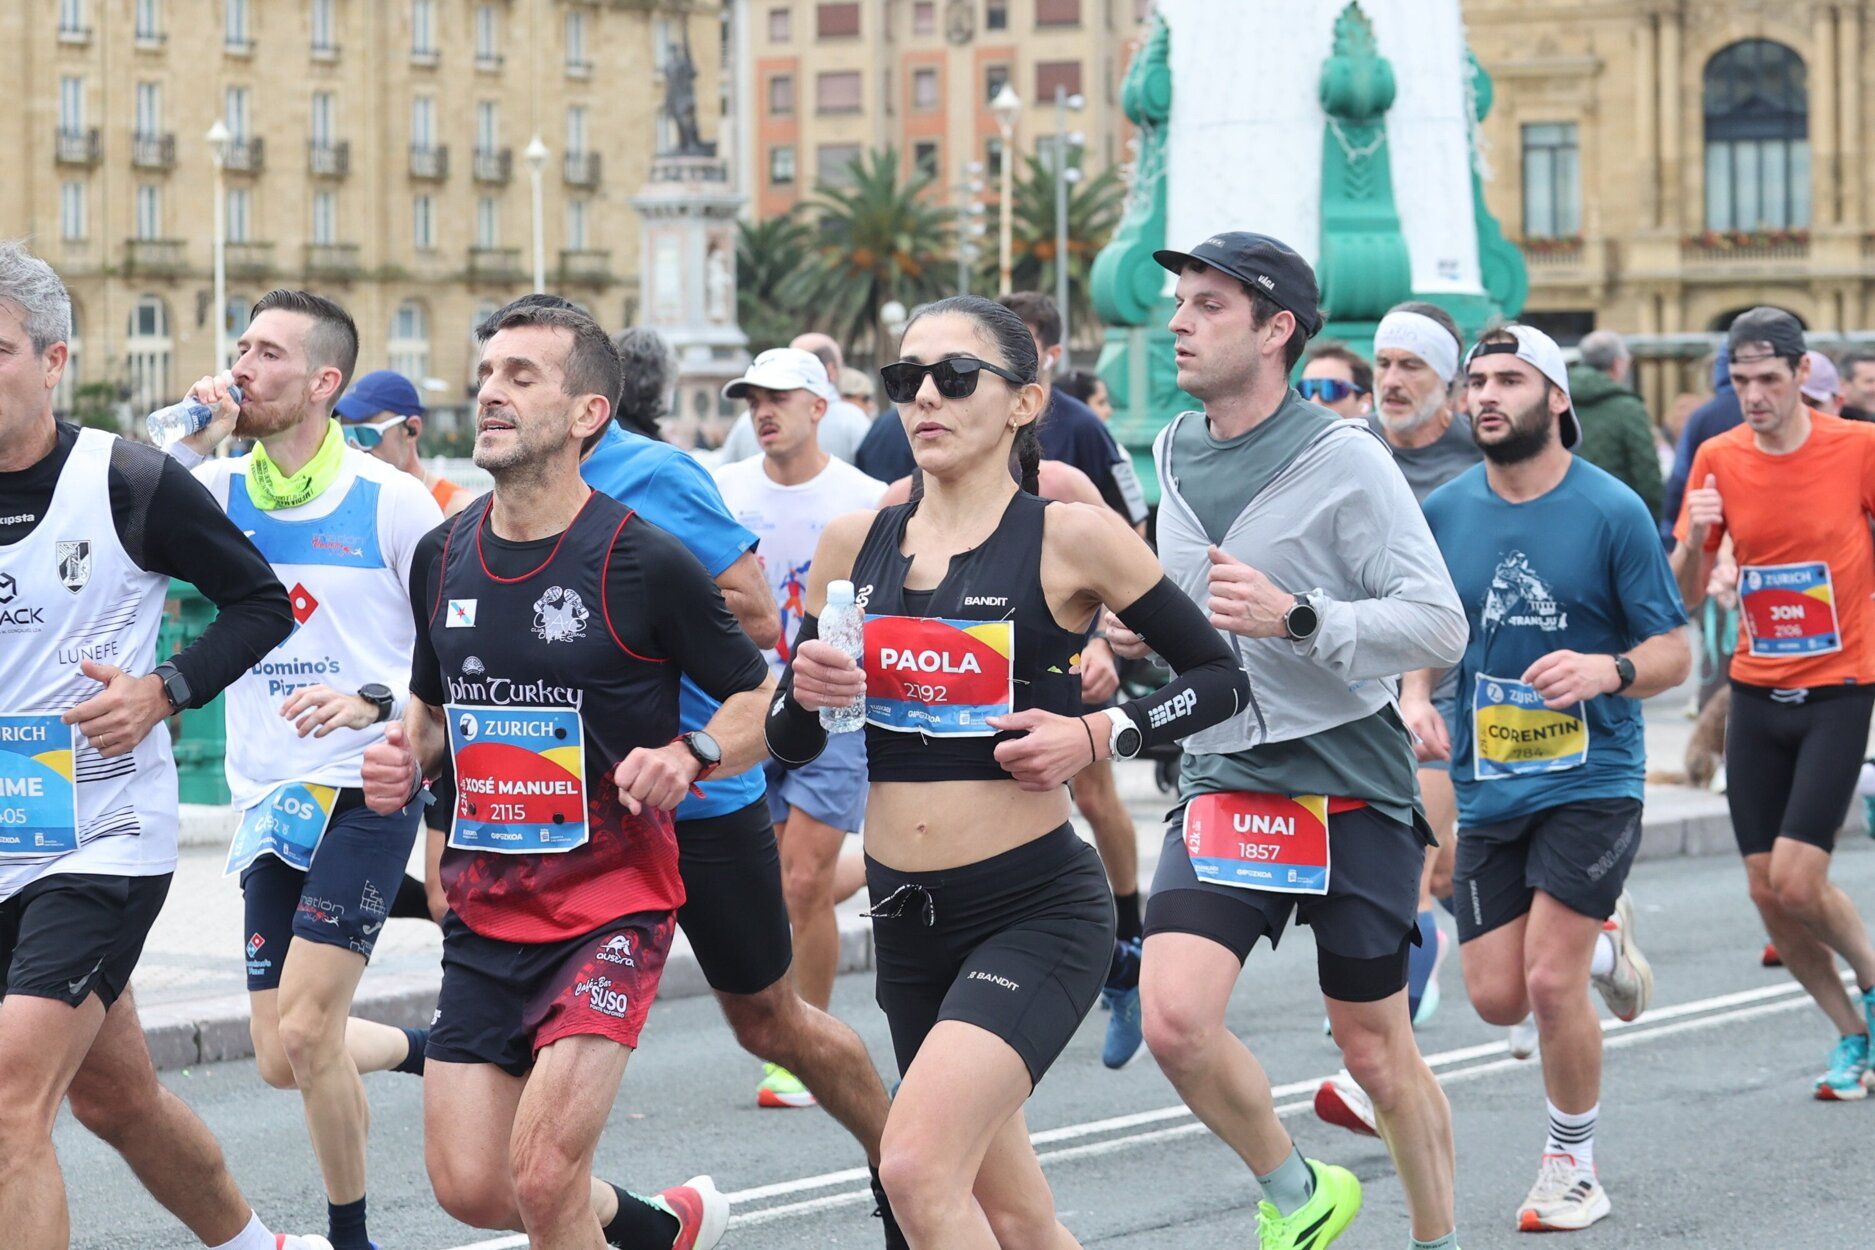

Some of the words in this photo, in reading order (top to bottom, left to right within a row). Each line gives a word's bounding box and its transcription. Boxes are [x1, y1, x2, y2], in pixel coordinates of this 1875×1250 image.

[1765, 571, 1812, 586] ZURICH
[964, 596, 1008, 606] BANDIT
[1769, 604, 1805, 621] JON
[58, 641, 118, 665] LUNEFE
[880, 648, 982, 674] PAOLA
[251, 656, 340, 676] Domino's
[268, 680, 321, 697] Piz
[447, 676, 487, 704] John
[486, 676, 584, 711] Turkey
[903, 682, 948, 702] 2192
[1509, 689, 1545, 705] ZURI
[485, 720, 555, 737] ZURICH
[1488, 720, 1580, 743] CORENTIN
[0, 777, 44, 797] IME
[465, 777, 495, 794] XOSÉ
[498, 781, 579, 795] MANUEL
[0, 808, 27, 824] 05
[489, 803, 526, 820] 2115
[1233, 813, 1295, 835] UNAI
[1238, 842, 1280, 860] 1857
[976, 971, 1020, 992] BANDIT
[590, 985, 628, 1013] SUSO
